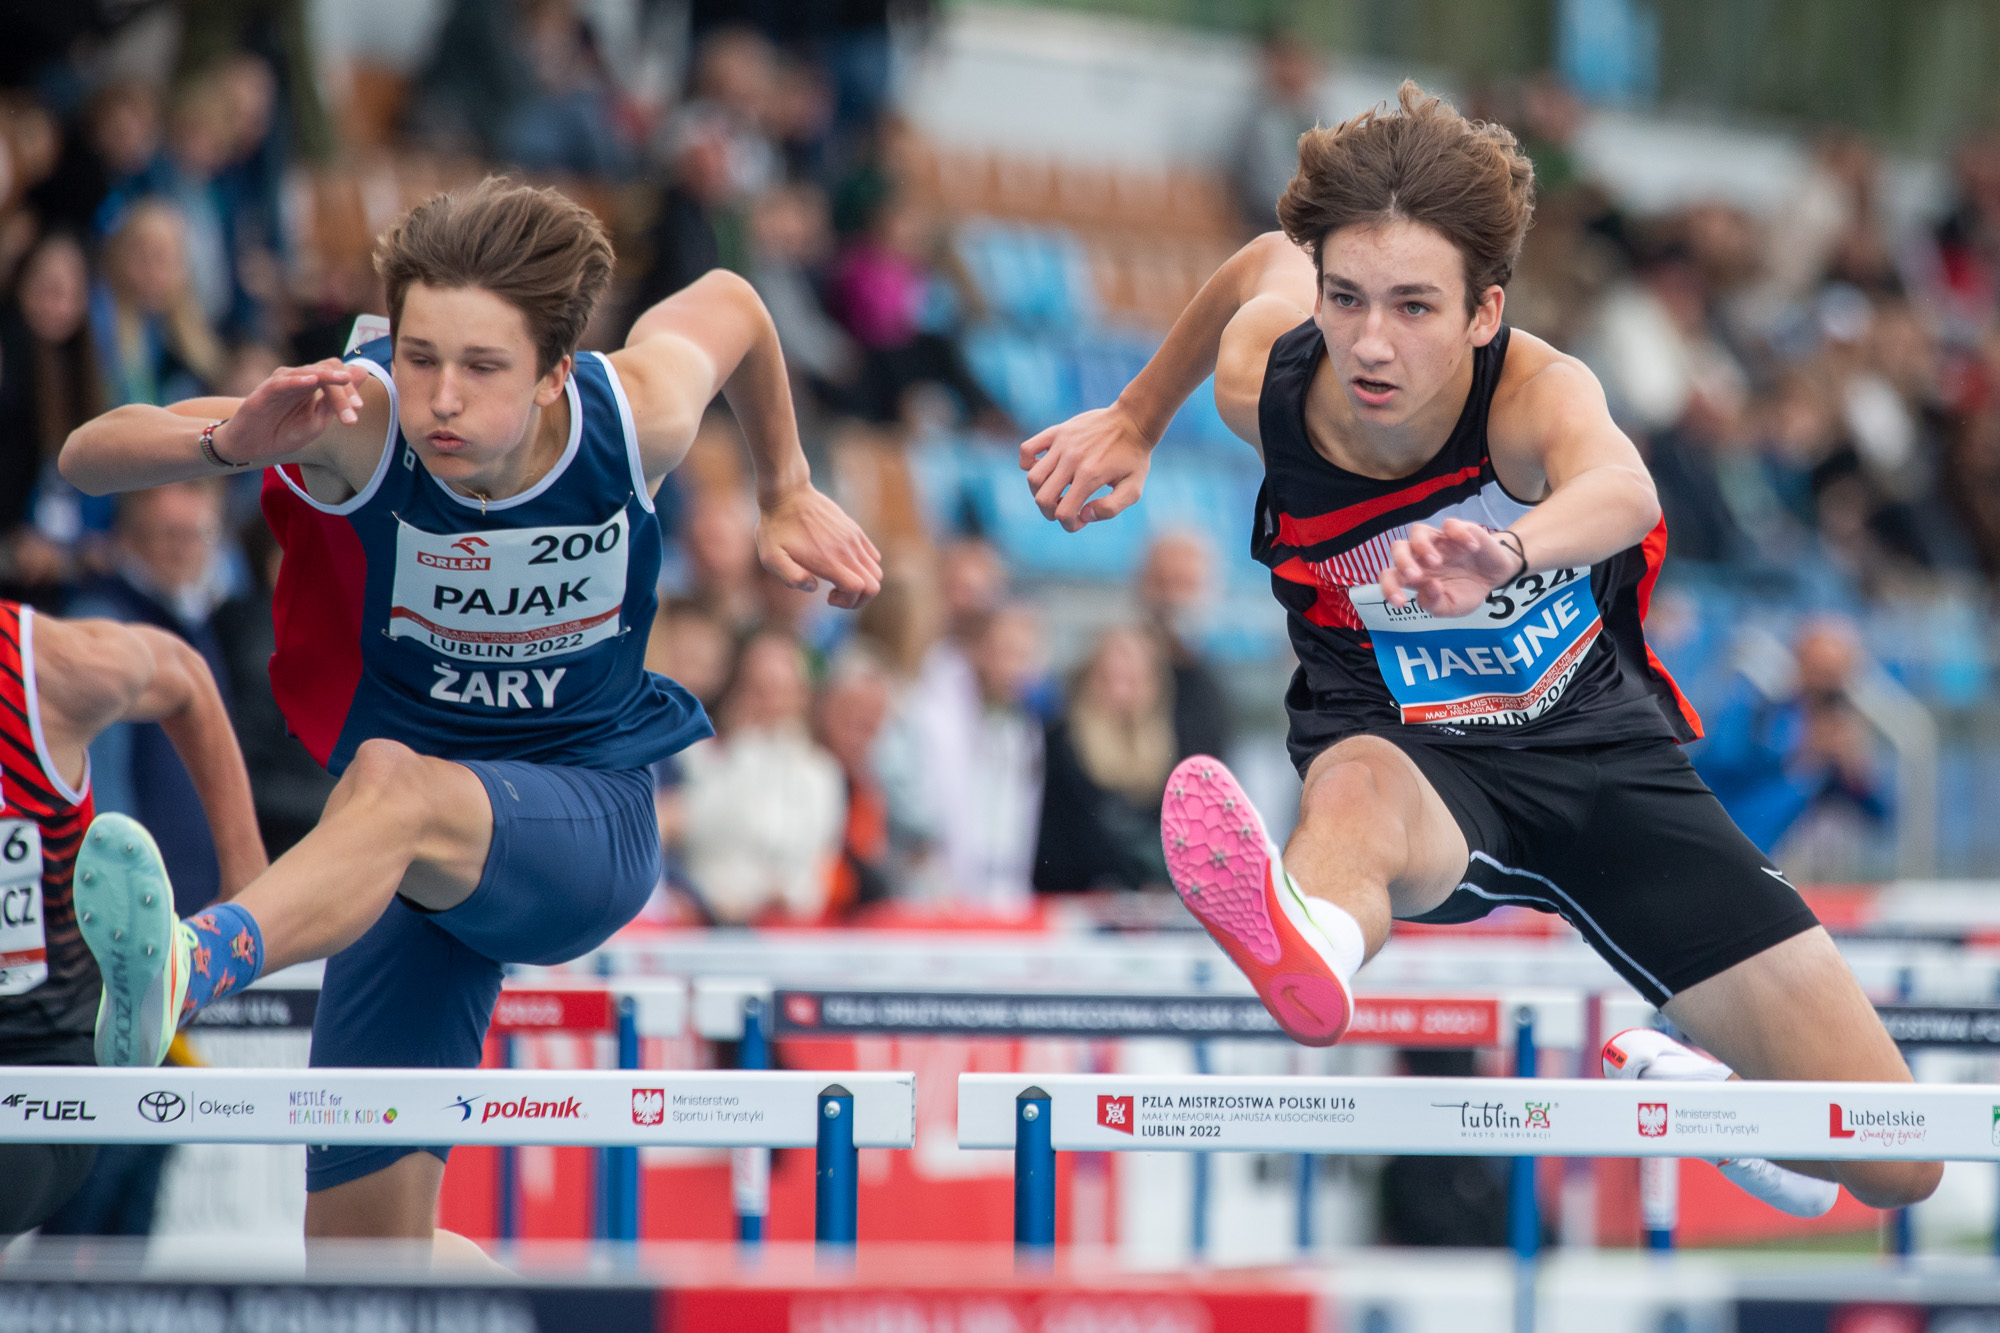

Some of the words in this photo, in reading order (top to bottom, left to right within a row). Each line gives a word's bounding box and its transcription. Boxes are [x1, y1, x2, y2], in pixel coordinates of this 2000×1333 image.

[420, 553, 488, 570] ORLEN
[528, 522, 621, 565] 200
[433, 576, 592, 616] PAJĄK
[1485, 568, 1578, 620] 534
[429, 633, 515, 658] LUBLIN
[522, 633, 585, 657] 2022
[1394, 591, 1581, 687] HAEHNE
[430, 661, 567, 709] ŻARY
[1536, 662, 1579, 716] 2022
[1, 1093, 28, 1107] 4F
[24, 1100, 97, 1121] FUEL
[199, 1100, 256, 1118] Okęcie
[329, 1093, 343, 1107] for
[672, 1094, 740, 1107] Ministerstwo
[1141, 1096, 1174, 1109] PZLA
[1178, 1096, 1275, 1109] MISTRZOSTWA
[1279, 1097, 1327, 1110] POLSKI
[1330, 1097, 1356, 1110] U16
[289, 1109, 351, 1125] HEALTHIER
[354, 1109, 380, 1125] KIDS
[481, 1095, 583, 1125] polanik
[672, 1110, 708, 1124] Sportu
[716, 1110, 765, 1124] Turystyki
[1141, 1112, 1170, 1122] MAŁY
[1172, 1112, 1226, 1122] MEMORIAŁ
[1228, 1112, 1272, 1122] JANUSZA
[1274, 1111, 1356, 1124] KUSOCIŃSKIEGO
[1431, 1101, 1521, 1128] lublin
[1675, 1108, 1737, 1120] Ministerstwo
[1141, 1124, 1186, 1137] LUBLIN
[1189, 1124, 1222, 1138] 2022
[1675, 1123, 1709, 1136] Sportu
[1715, 1123, 1760, 1137] Turystyki
[1860, 1128, 1896, 1147] Smakuj
